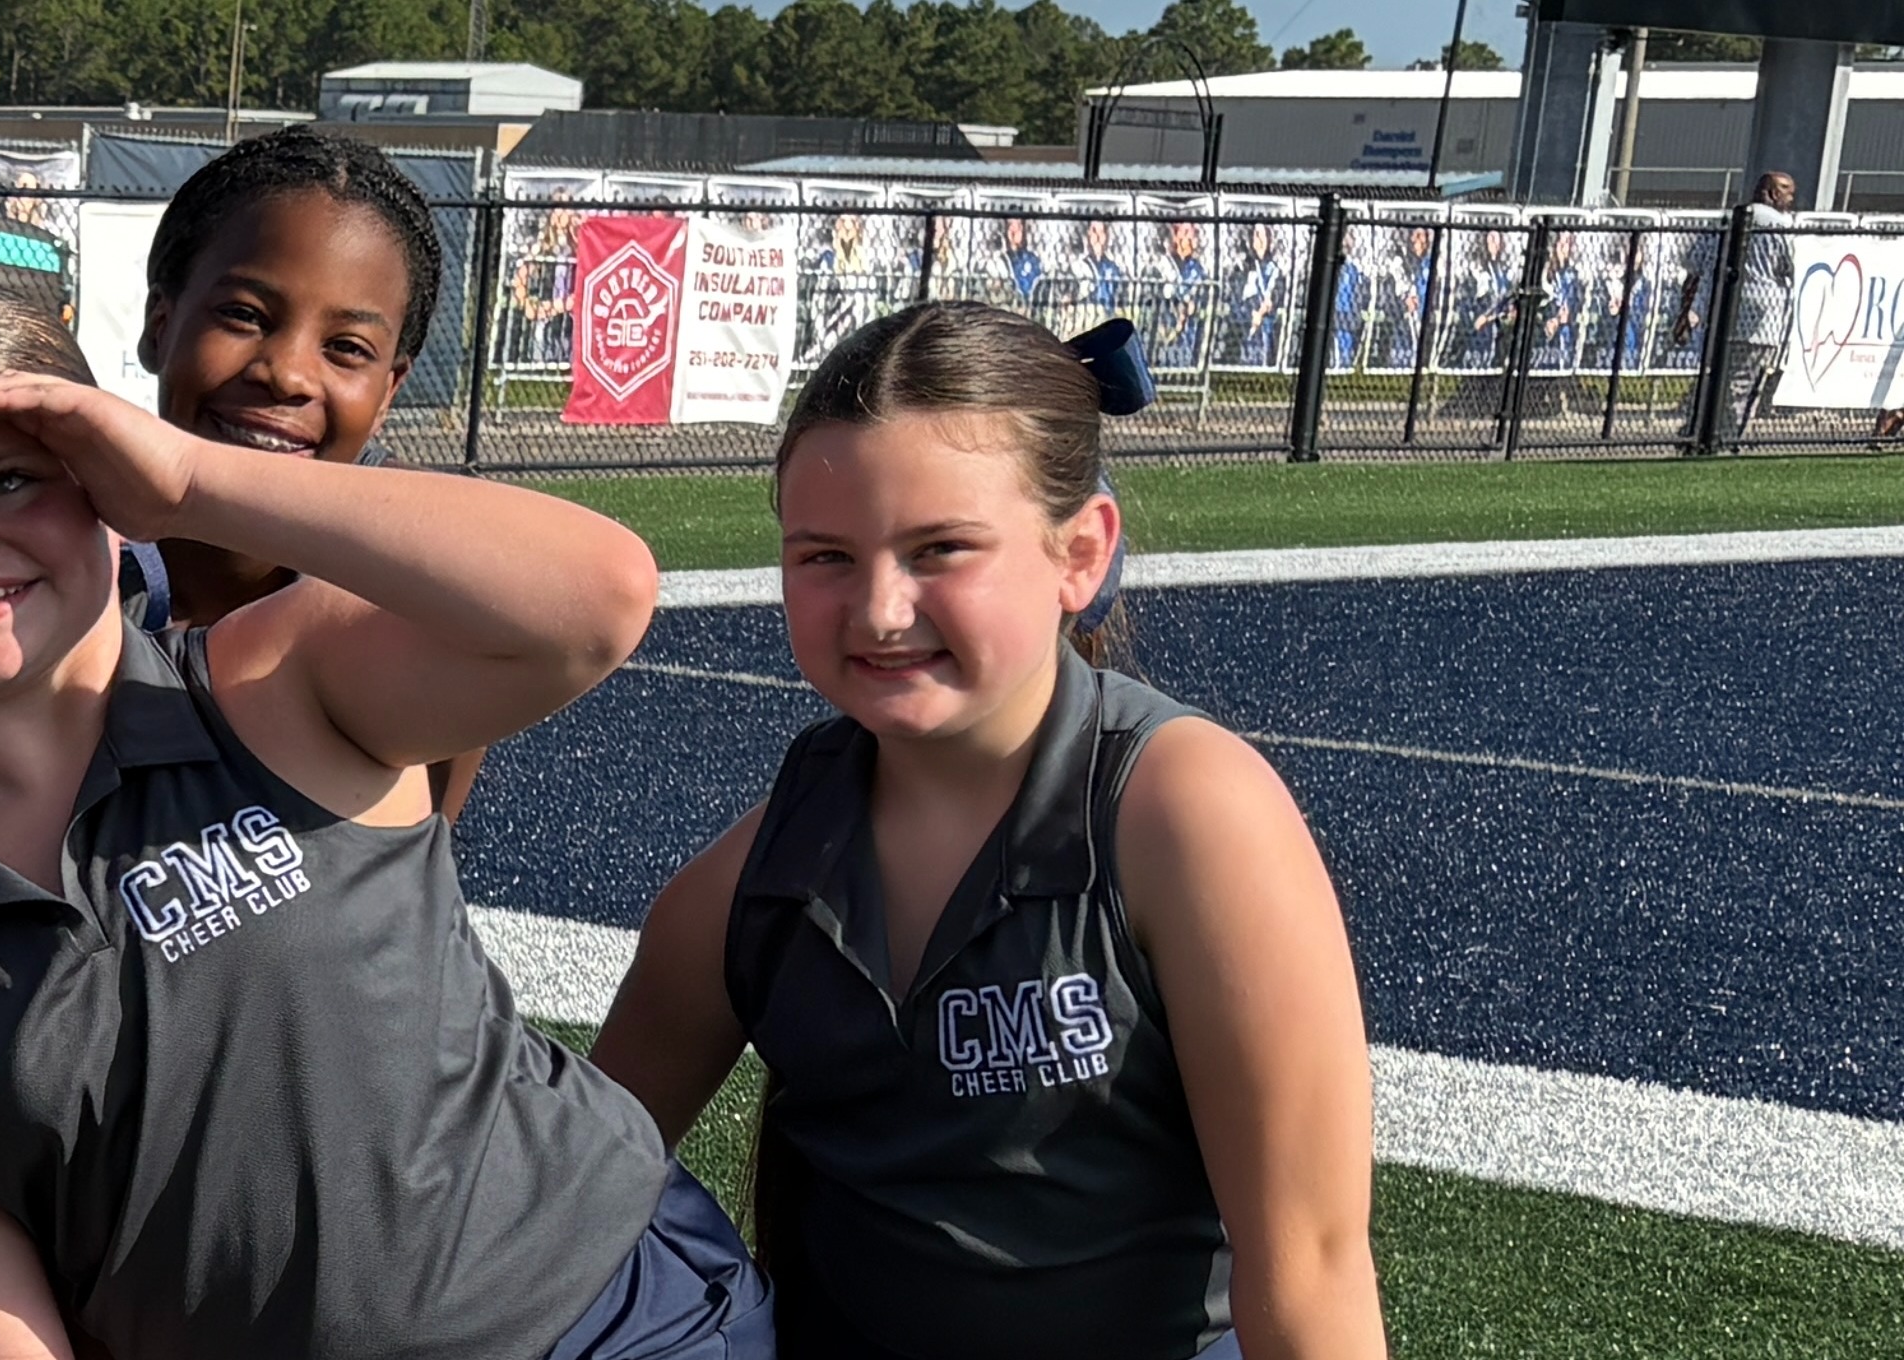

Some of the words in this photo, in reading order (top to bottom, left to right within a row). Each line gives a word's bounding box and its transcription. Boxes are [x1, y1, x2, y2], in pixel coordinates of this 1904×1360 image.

[593, 266, 659, 320] SOUTHER
[693, 271, 786, 297] INSULATION
[698, 300, 778, 326] COMPANY
[119, 805, 304, 943] CMS
[160, 905, 242, 963] CHEER
[245, 868, 312, 916] CLUB
[938, 972, 1114, 1071] CMS
[951, 1069, 1027, 1097] CHEER
[1038, 1053, 1110, 1088] CLUB
